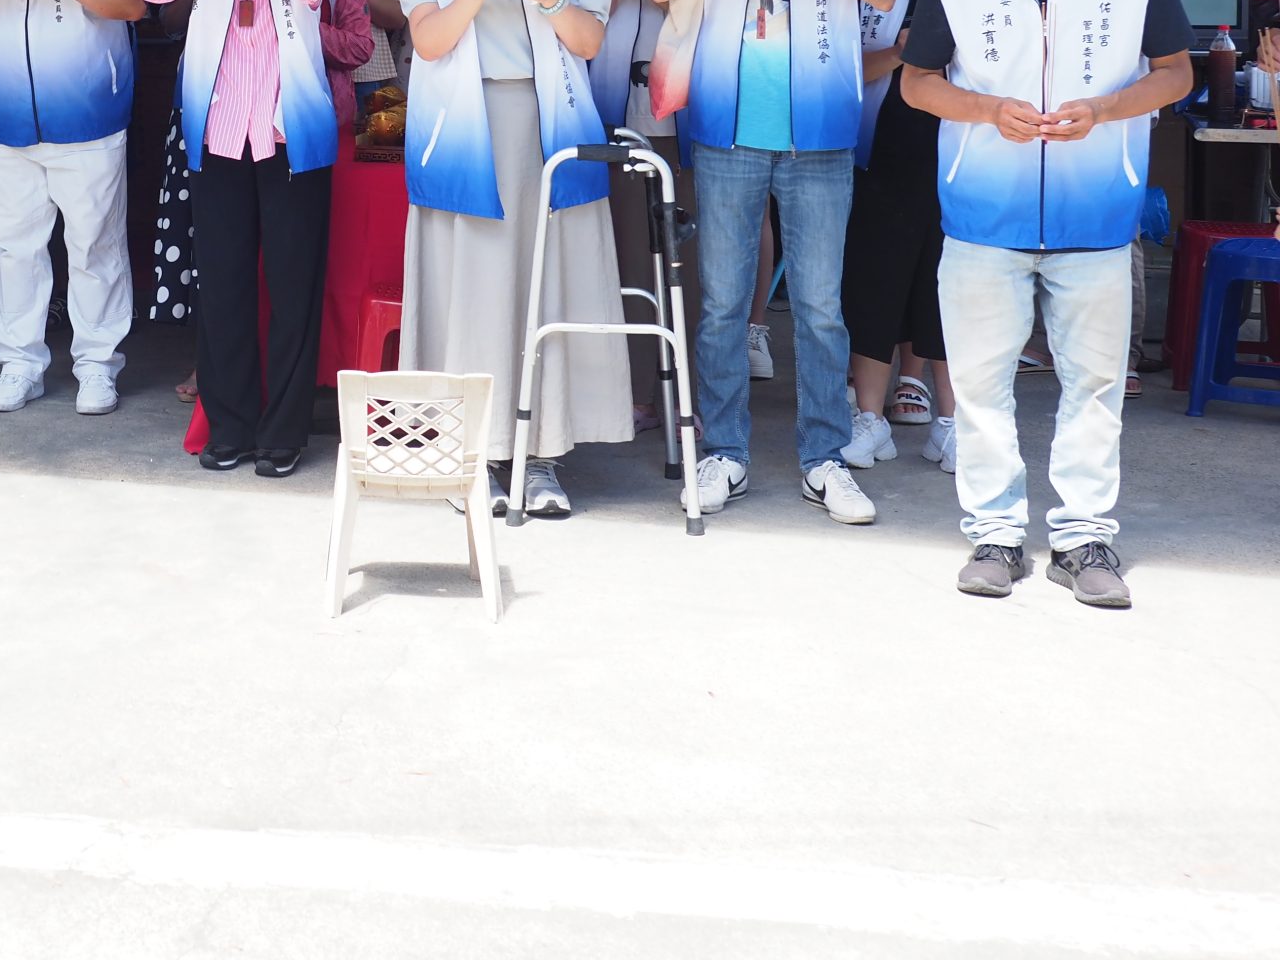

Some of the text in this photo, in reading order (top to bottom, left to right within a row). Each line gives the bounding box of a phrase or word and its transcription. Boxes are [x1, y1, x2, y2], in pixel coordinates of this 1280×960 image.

[982, 12, 1000, 63] 洪育德
[1099, 2, 1112, 47] 佑昌宮
[1082, 20, 1094, 85] 管理委員會
